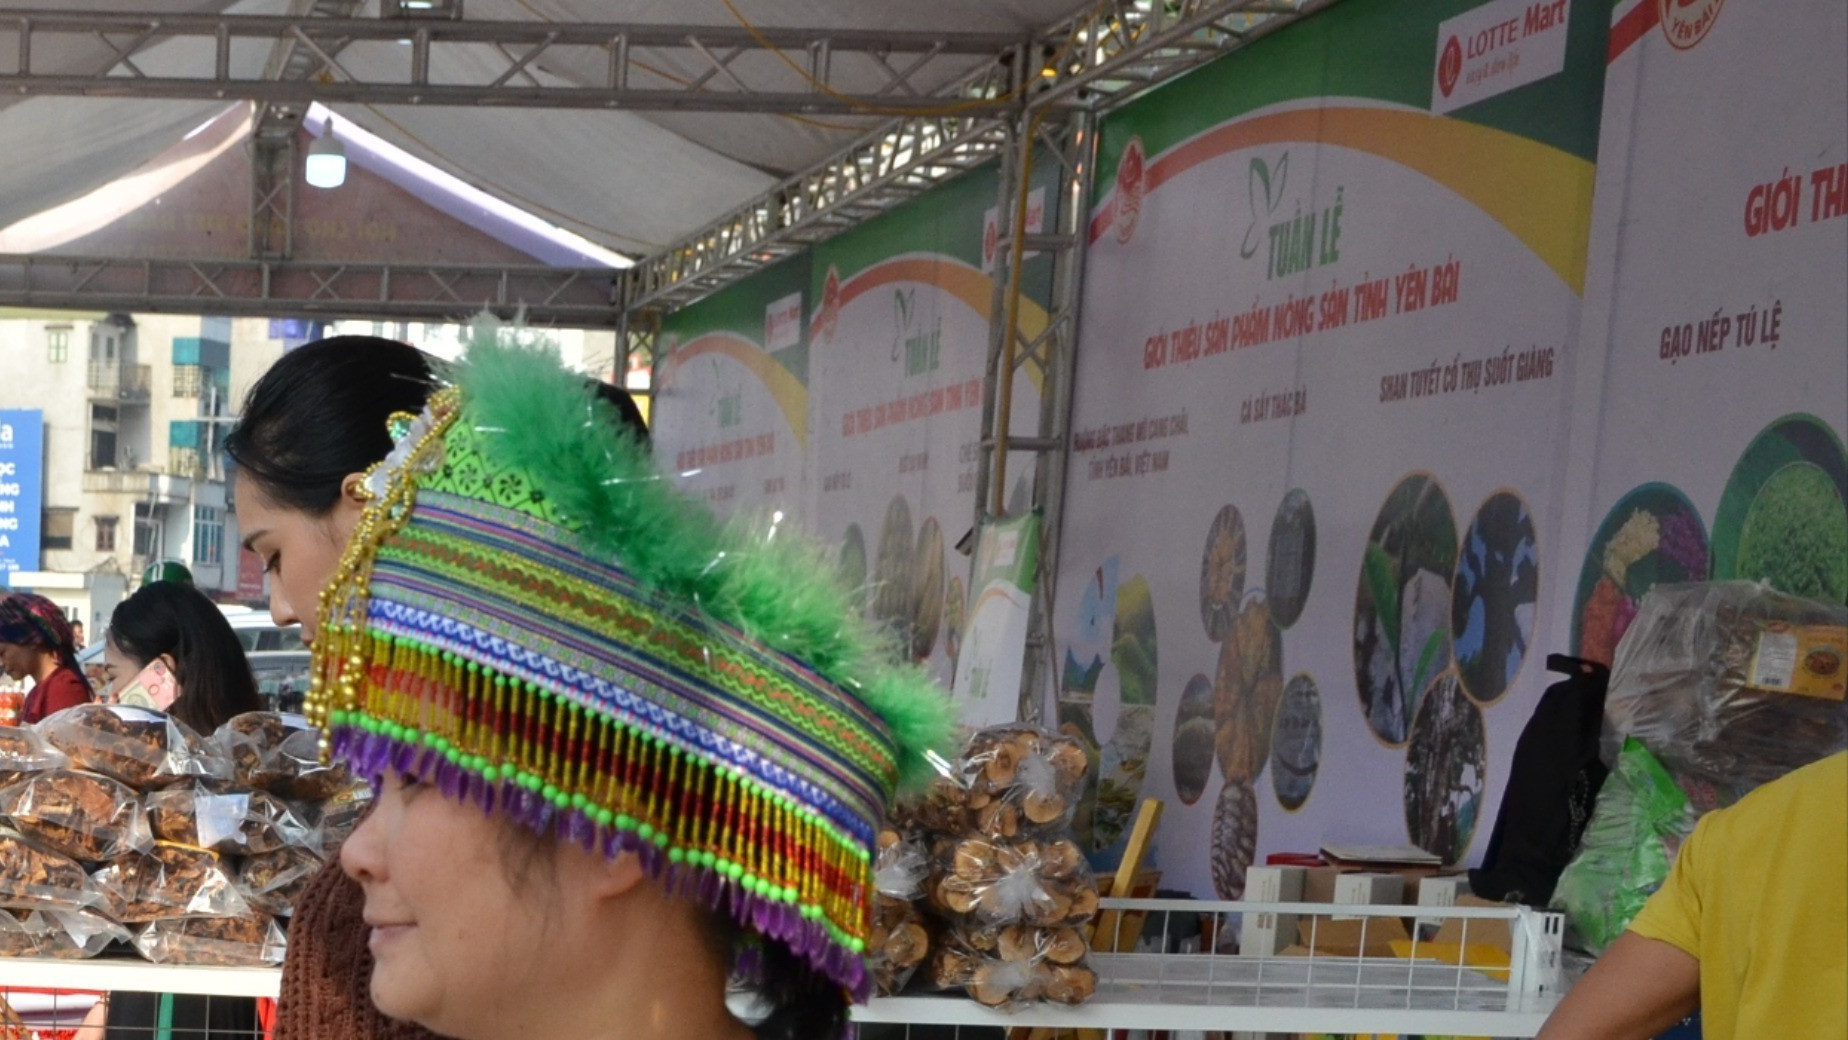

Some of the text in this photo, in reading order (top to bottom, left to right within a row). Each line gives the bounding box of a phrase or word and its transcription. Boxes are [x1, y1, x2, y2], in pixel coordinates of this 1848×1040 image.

[1466, 18, 1518, 59] LOTTE
[1744, 167, 1802, 238] GIỚI
[1395, 263, 1427, 314] YÊN
[1659, 300, 1782, 365] GẠO NẾP TÚ LỆ
